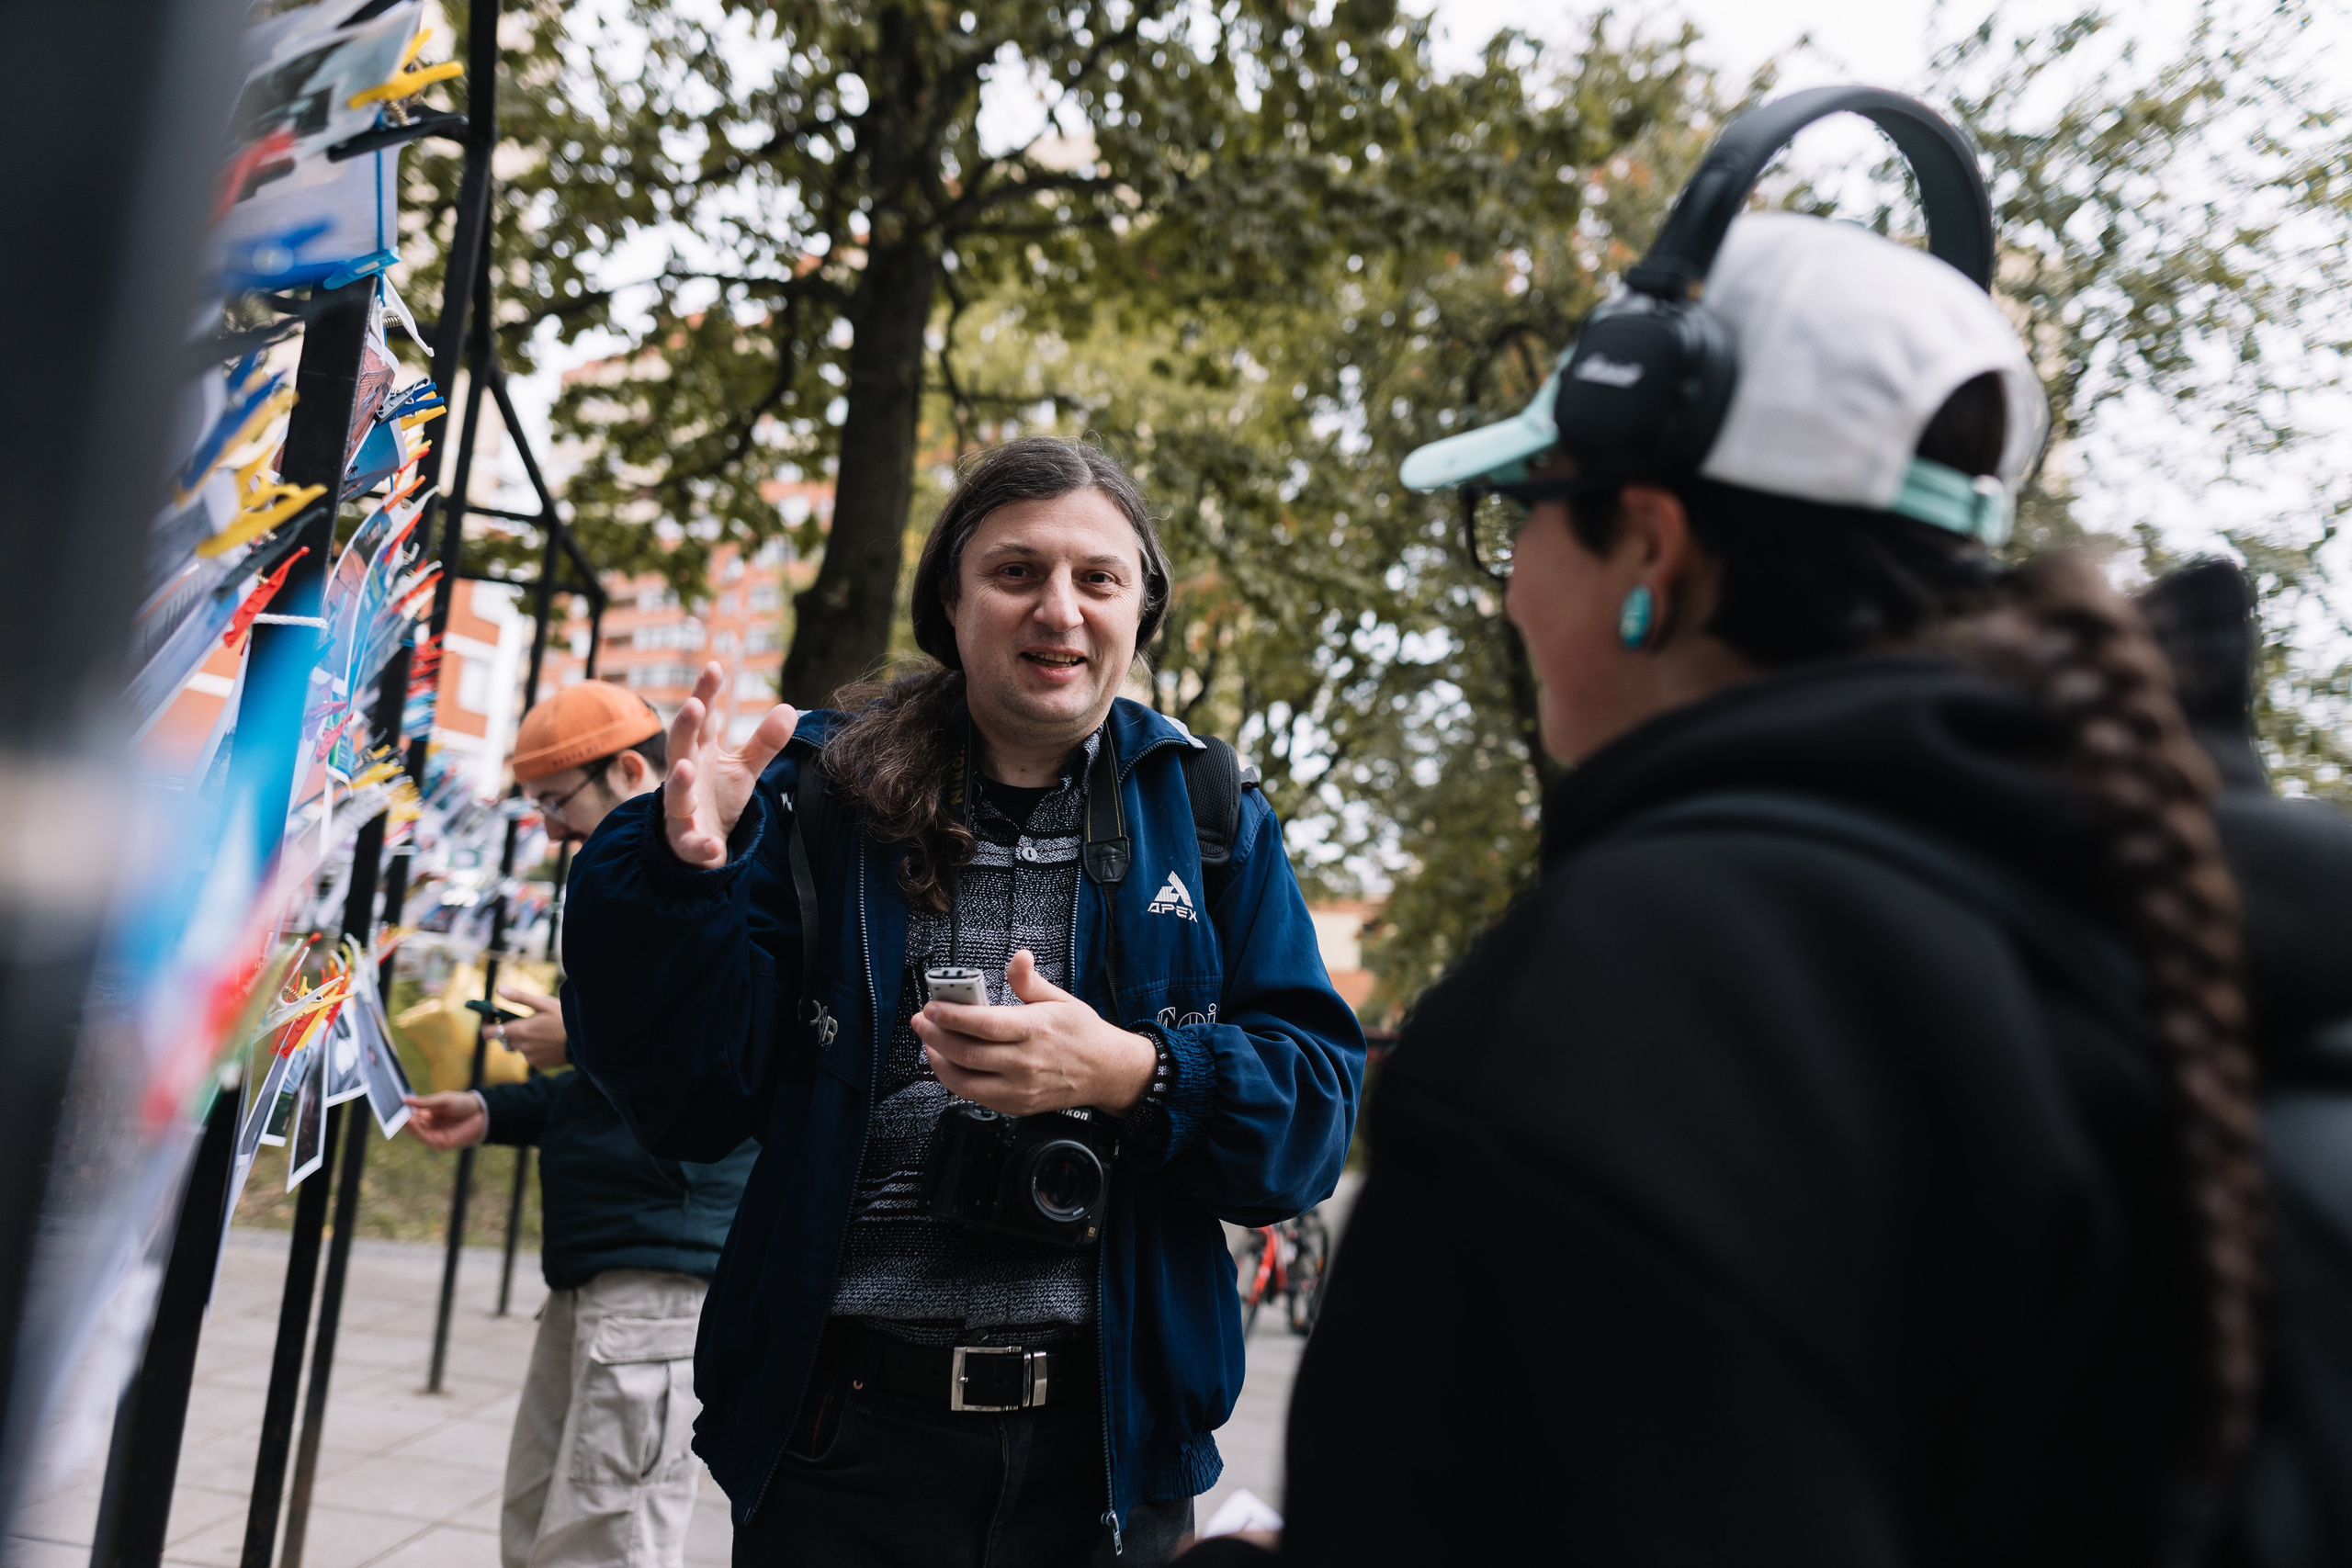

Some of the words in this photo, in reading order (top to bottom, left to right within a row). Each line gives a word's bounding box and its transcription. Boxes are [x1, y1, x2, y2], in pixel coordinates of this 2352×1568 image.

[949, 743, 966, 806] NIKO
[1147, 902, 1198, 923] APEX
[1057, 1108, 1089, 1121] ikon
